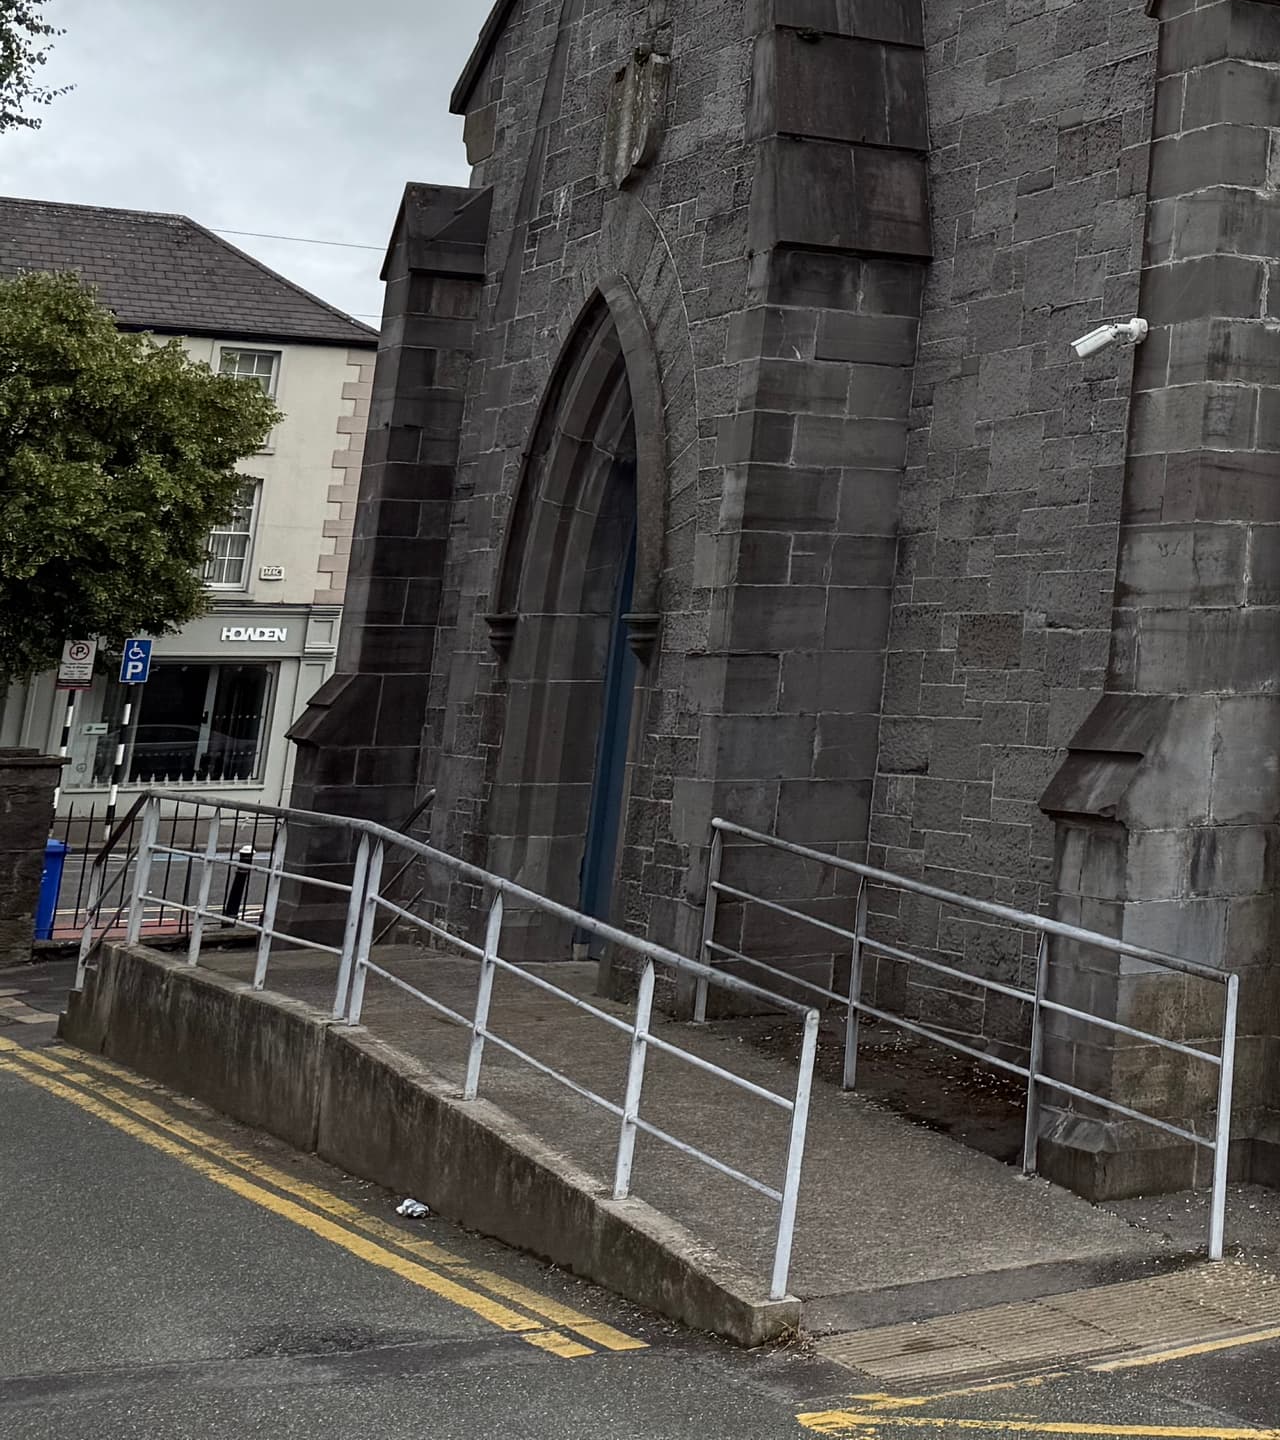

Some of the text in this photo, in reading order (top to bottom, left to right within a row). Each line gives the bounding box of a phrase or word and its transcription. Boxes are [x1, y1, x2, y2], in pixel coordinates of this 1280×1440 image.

[221, 627, 288, 641] HOWDEN
[76, 646, 84, 657] P
[126, 661, 143, 679] P
